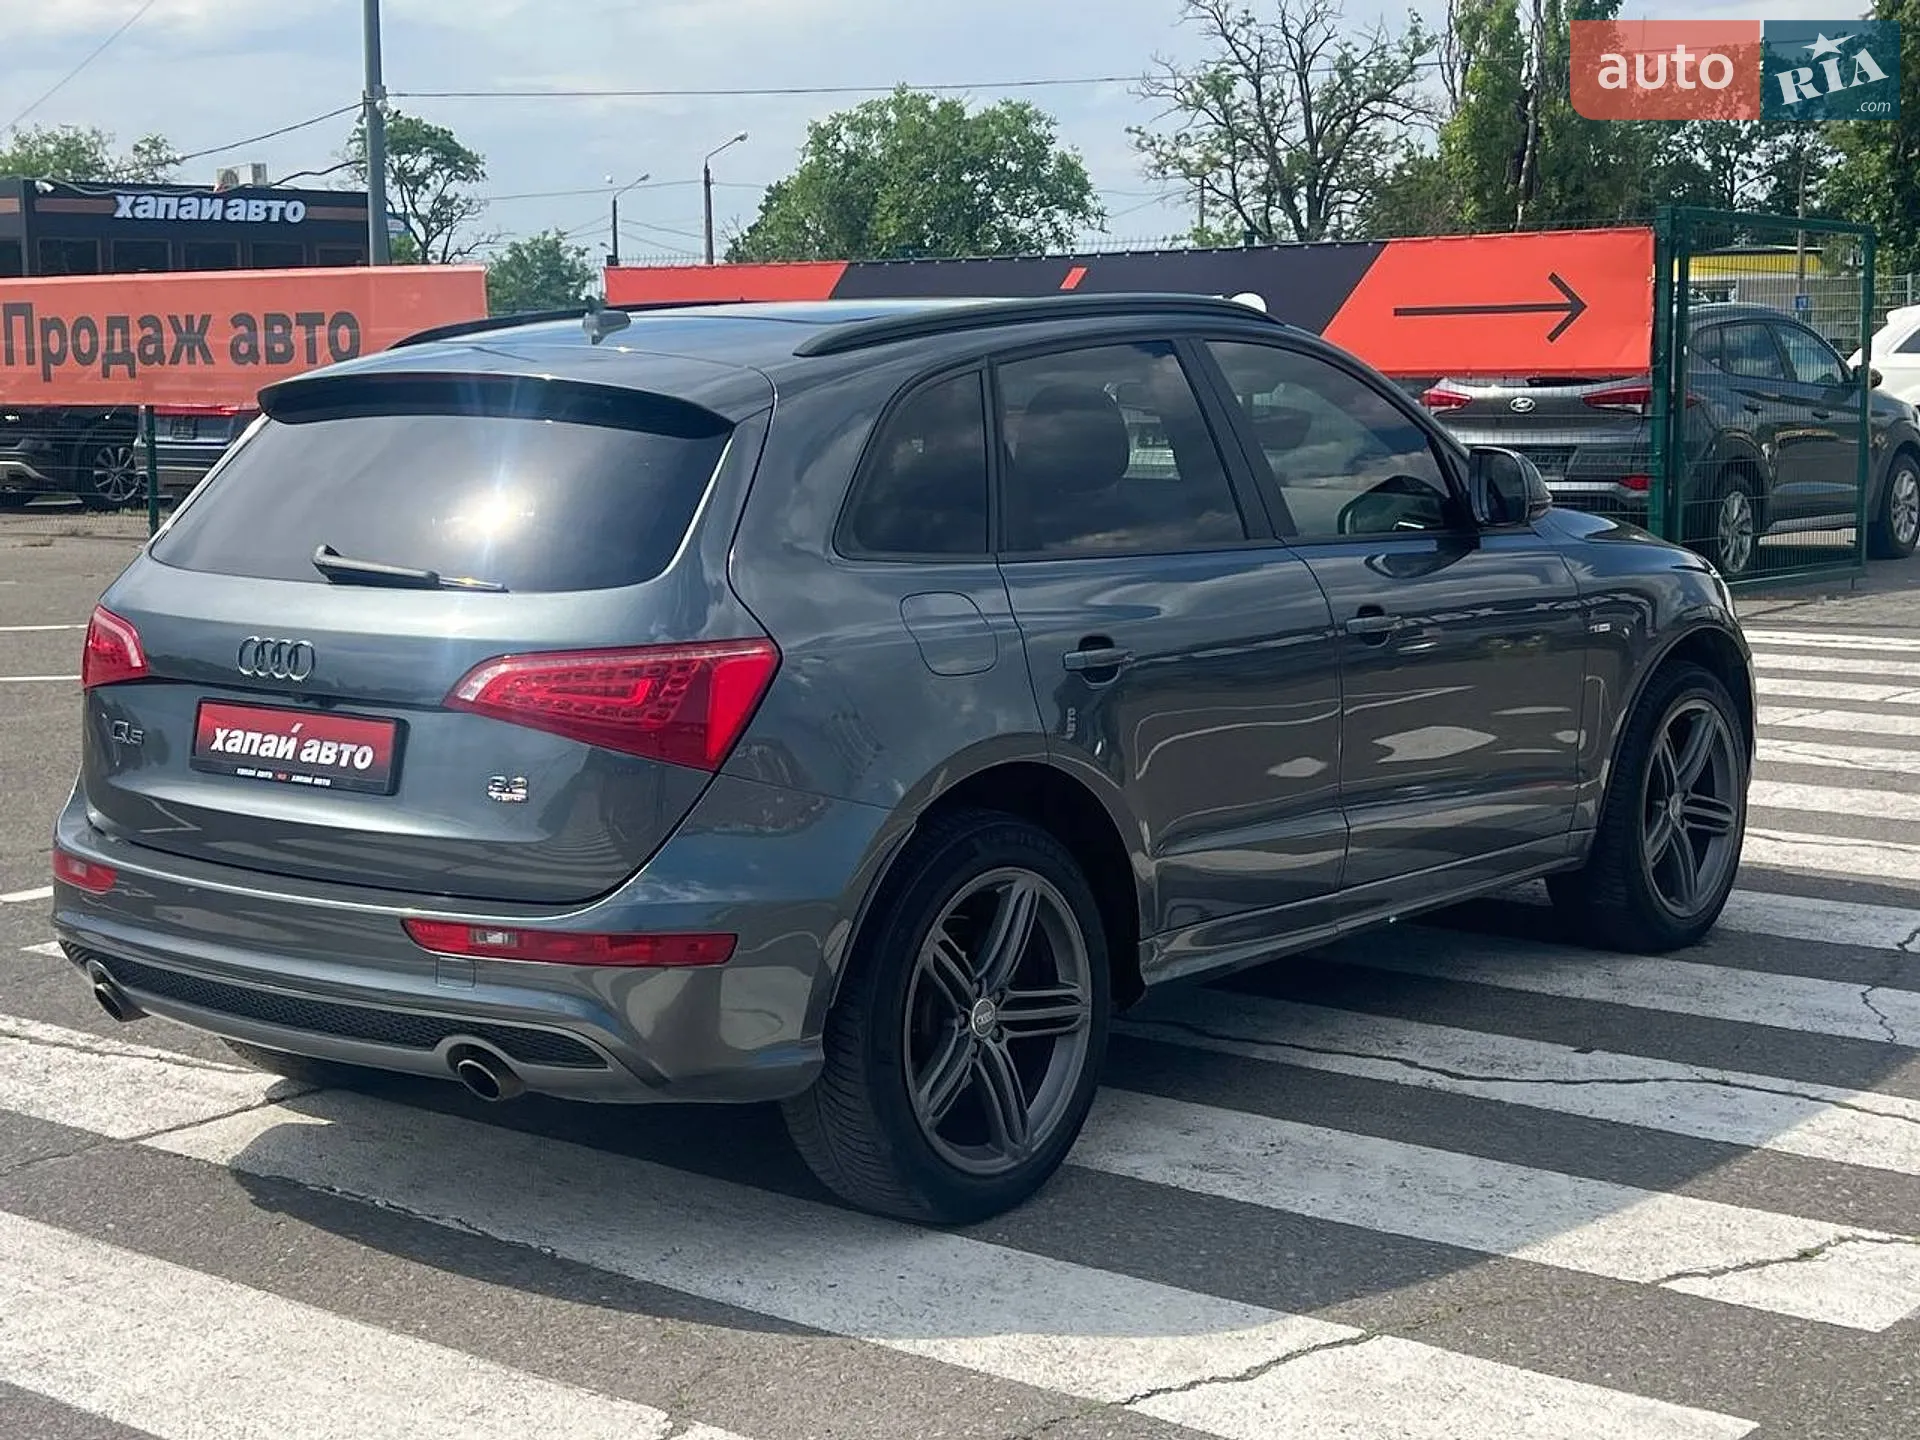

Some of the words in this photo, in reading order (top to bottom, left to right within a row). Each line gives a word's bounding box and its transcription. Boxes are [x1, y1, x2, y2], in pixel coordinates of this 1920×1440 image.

[2, 302, 215, 382] Продаж
[229, 311, 361, 366] авто
[111, 720, 144, 744] Q5
[300, 739, 374, 770] авто
